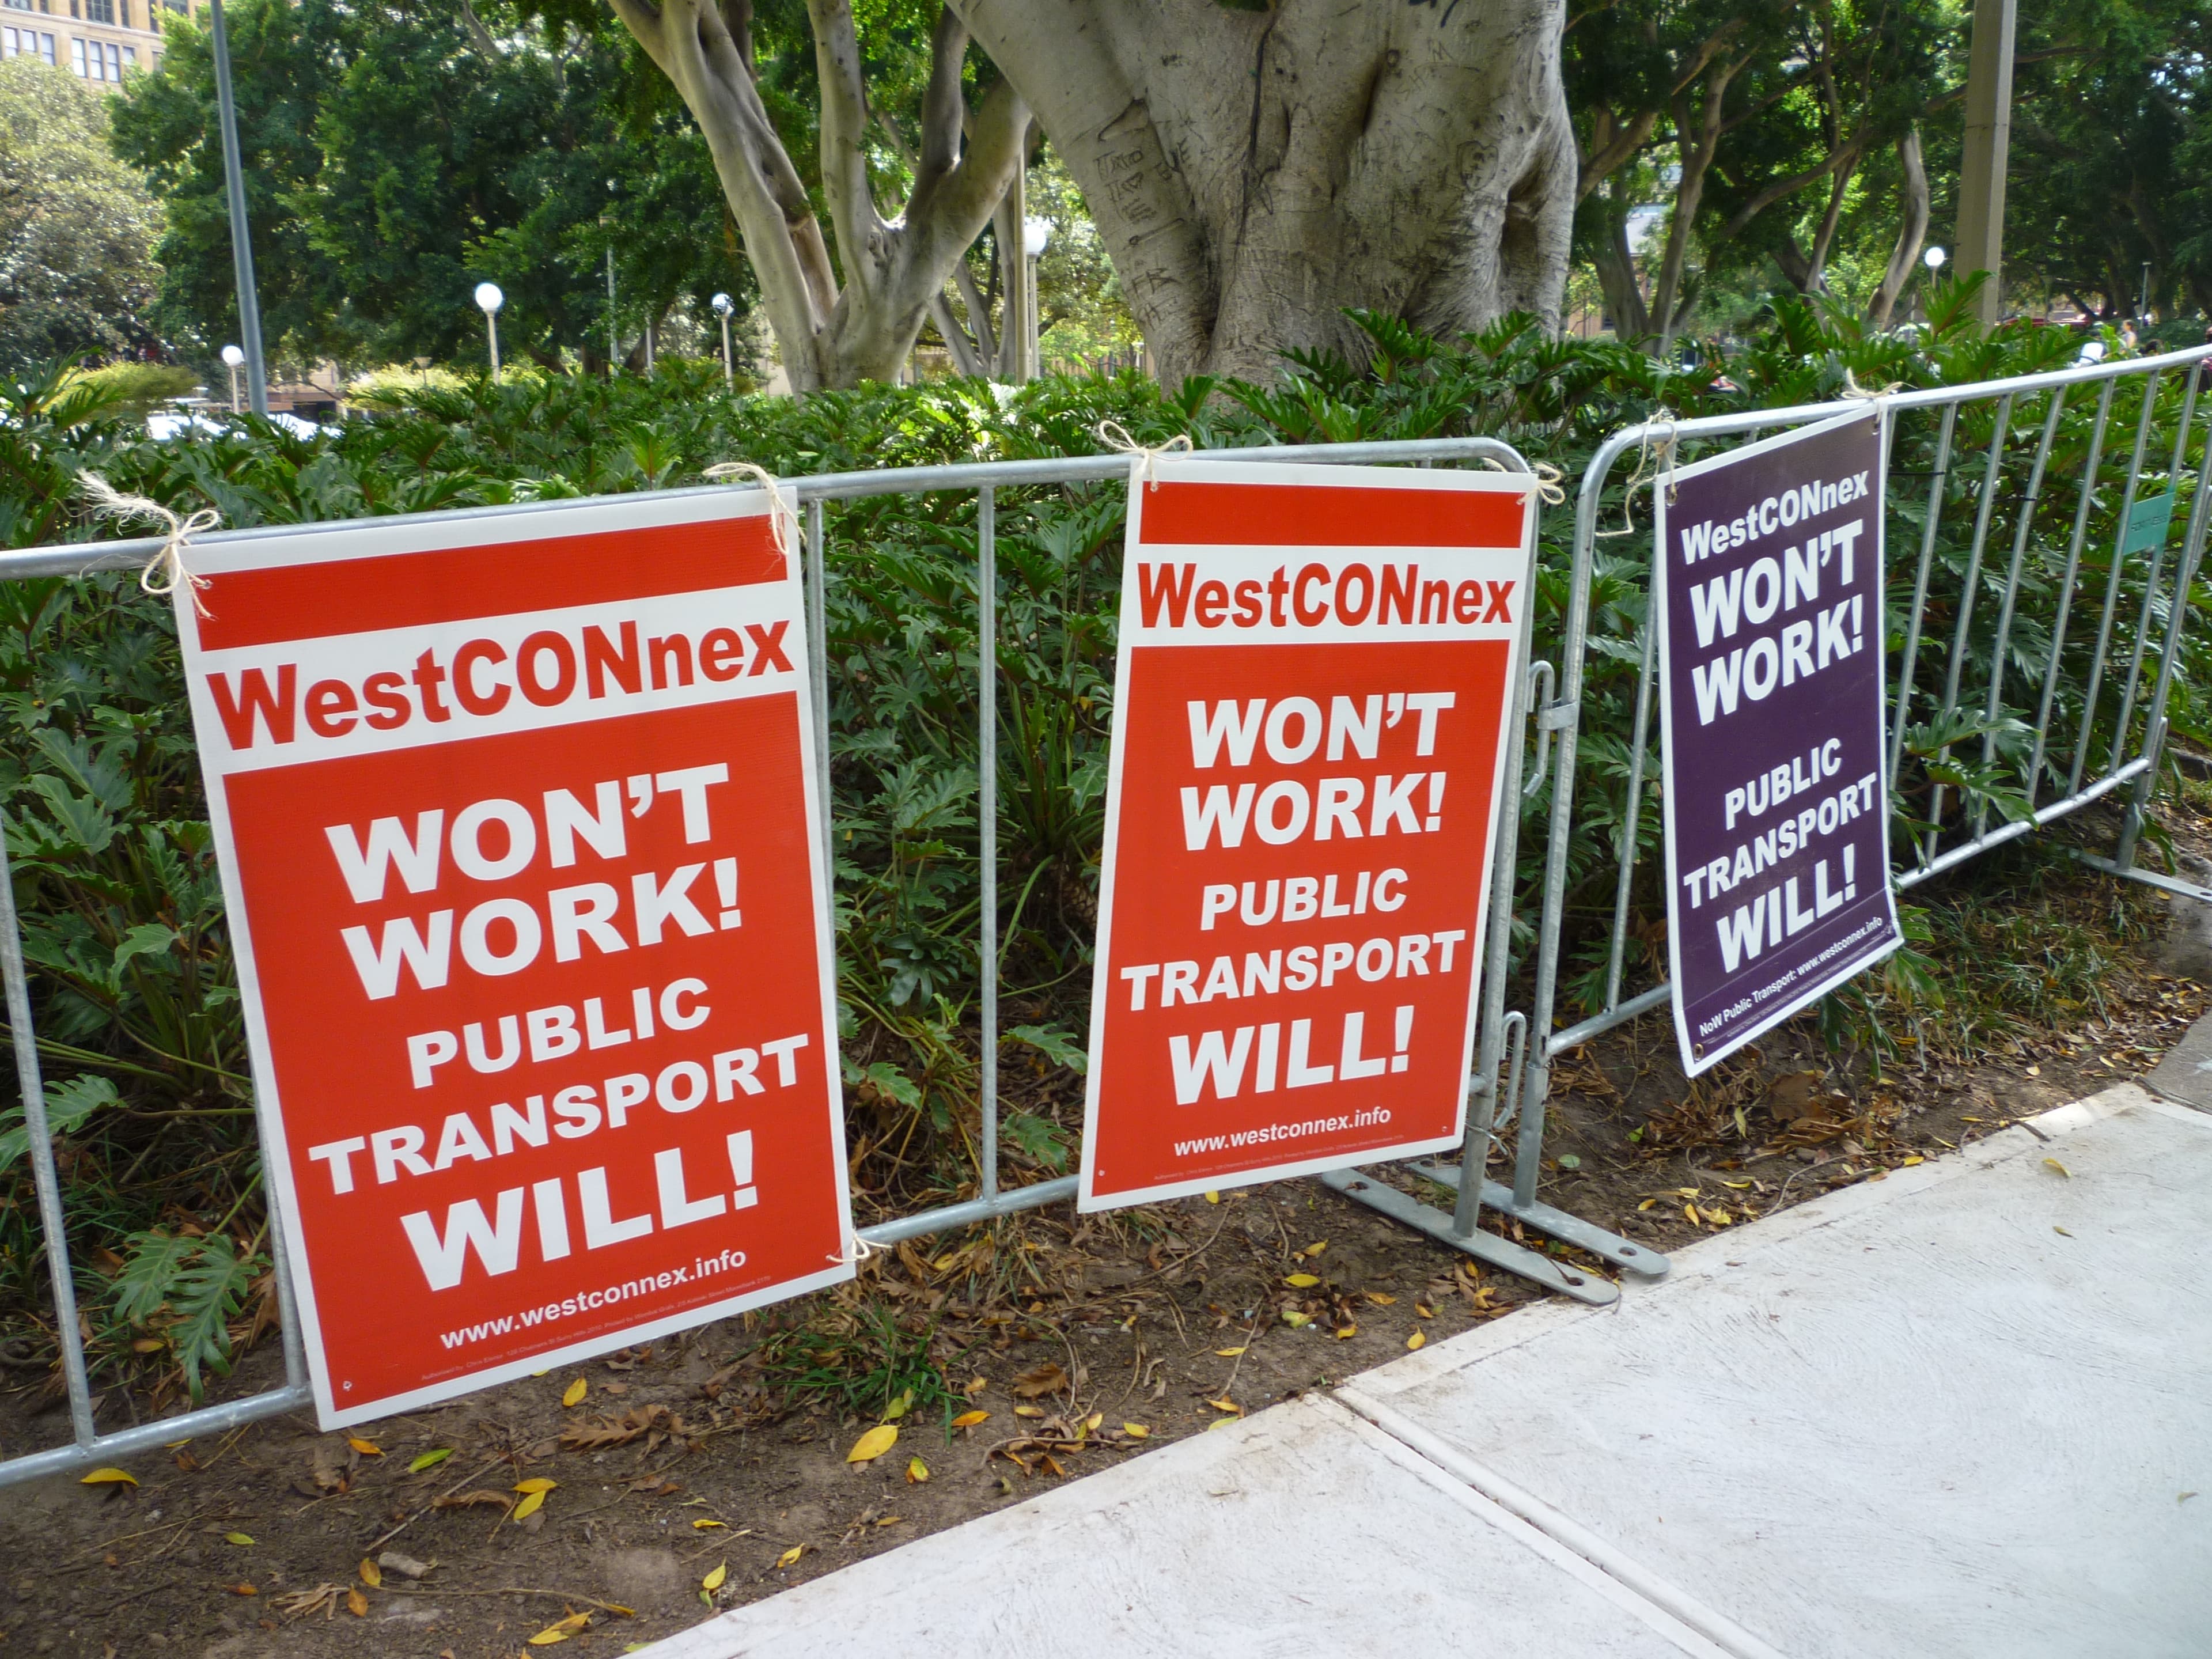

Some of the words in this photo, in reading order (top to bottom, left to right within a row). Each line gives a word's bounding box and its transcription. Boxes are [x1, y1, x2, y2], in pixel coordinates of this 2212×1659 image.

[1681, 470, 1869, 565] WestCONnex
[1139, 563, 1514, 628] WestCONnex
[1690, 519, 1863, 648] WON'T
[207, 621, 793, 749] WestCONnex
[1692, 594, 1862, 726] WORK!
[1187, 692, 1455, 768] WON'T
[1725, 738, 1841, 830] PUBLIC
[324, 763, 729, 903] WON'T
[1180, 772, 1446, 850] WORK!
[1684, 772, 1876, 908] TRANSPORT
[341, 857, 741, 1000] WORK!
[1201, 868, 1408, 930] PUBLIC
[1717, 843, 1855, 973] WILL!
[1121, 930, 1465, 1011] TRANSPORT
[1699, 1013, 1722, 1036] NoW
[1723, 997, 1752, 1022] Public
[1751, 969, 1797, 1003] Transport:
[1796, 916, 1883, 976] www.westconnex.info
[407, 978, 710, 1089] PUBLIC
[1169, 1005, 1414, 1105] WILL!
[309, 1033, 808, 1194] TRANSPORT
[1175, 1106, 1391, 1156] www.westconnex.info
[400, 1130, 757, 1291] WILL!
[441, 1249, 746, 1349] www.westconnex.info
